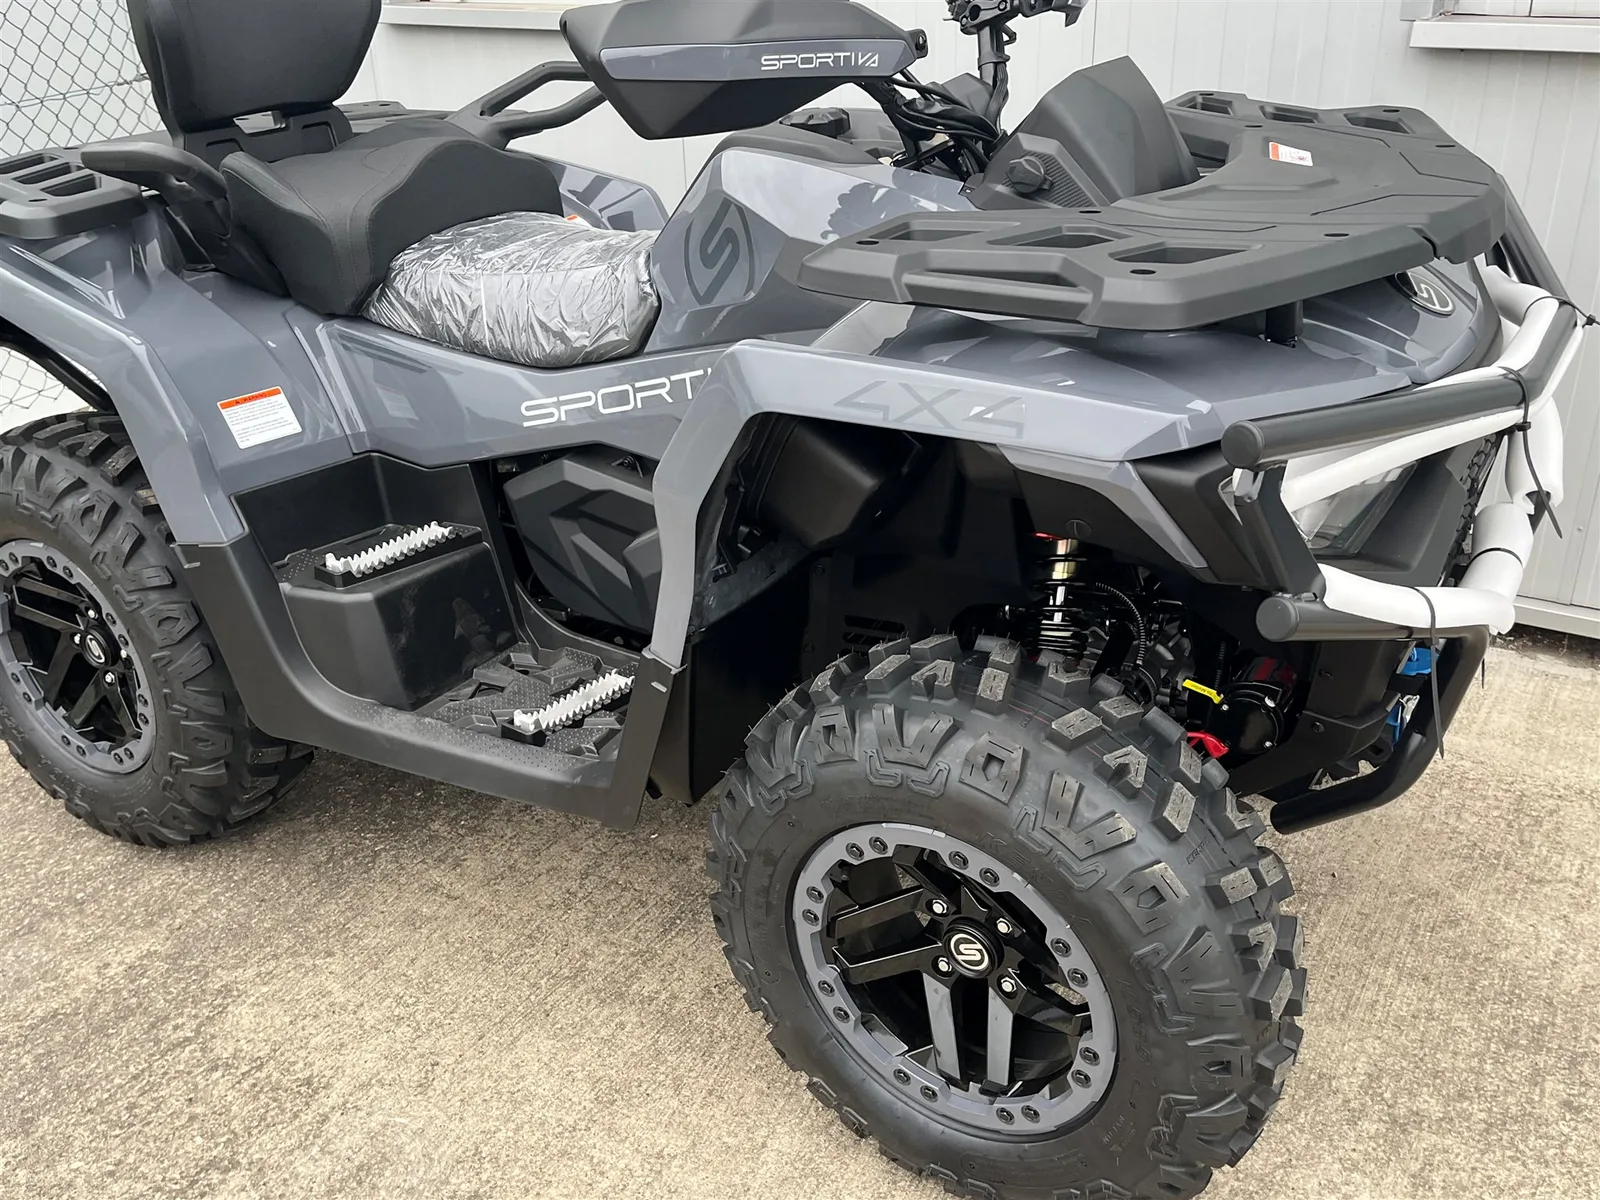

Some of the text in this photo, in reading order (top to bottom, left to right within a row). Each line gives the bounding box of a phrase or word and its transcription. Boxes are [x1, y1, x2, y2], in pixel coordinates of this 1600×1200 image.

[760, 51, 879, 71] SPORTIVA
[520, 367, 712, 427] SPORT
[834, 380, 1024, 439] 4X4
